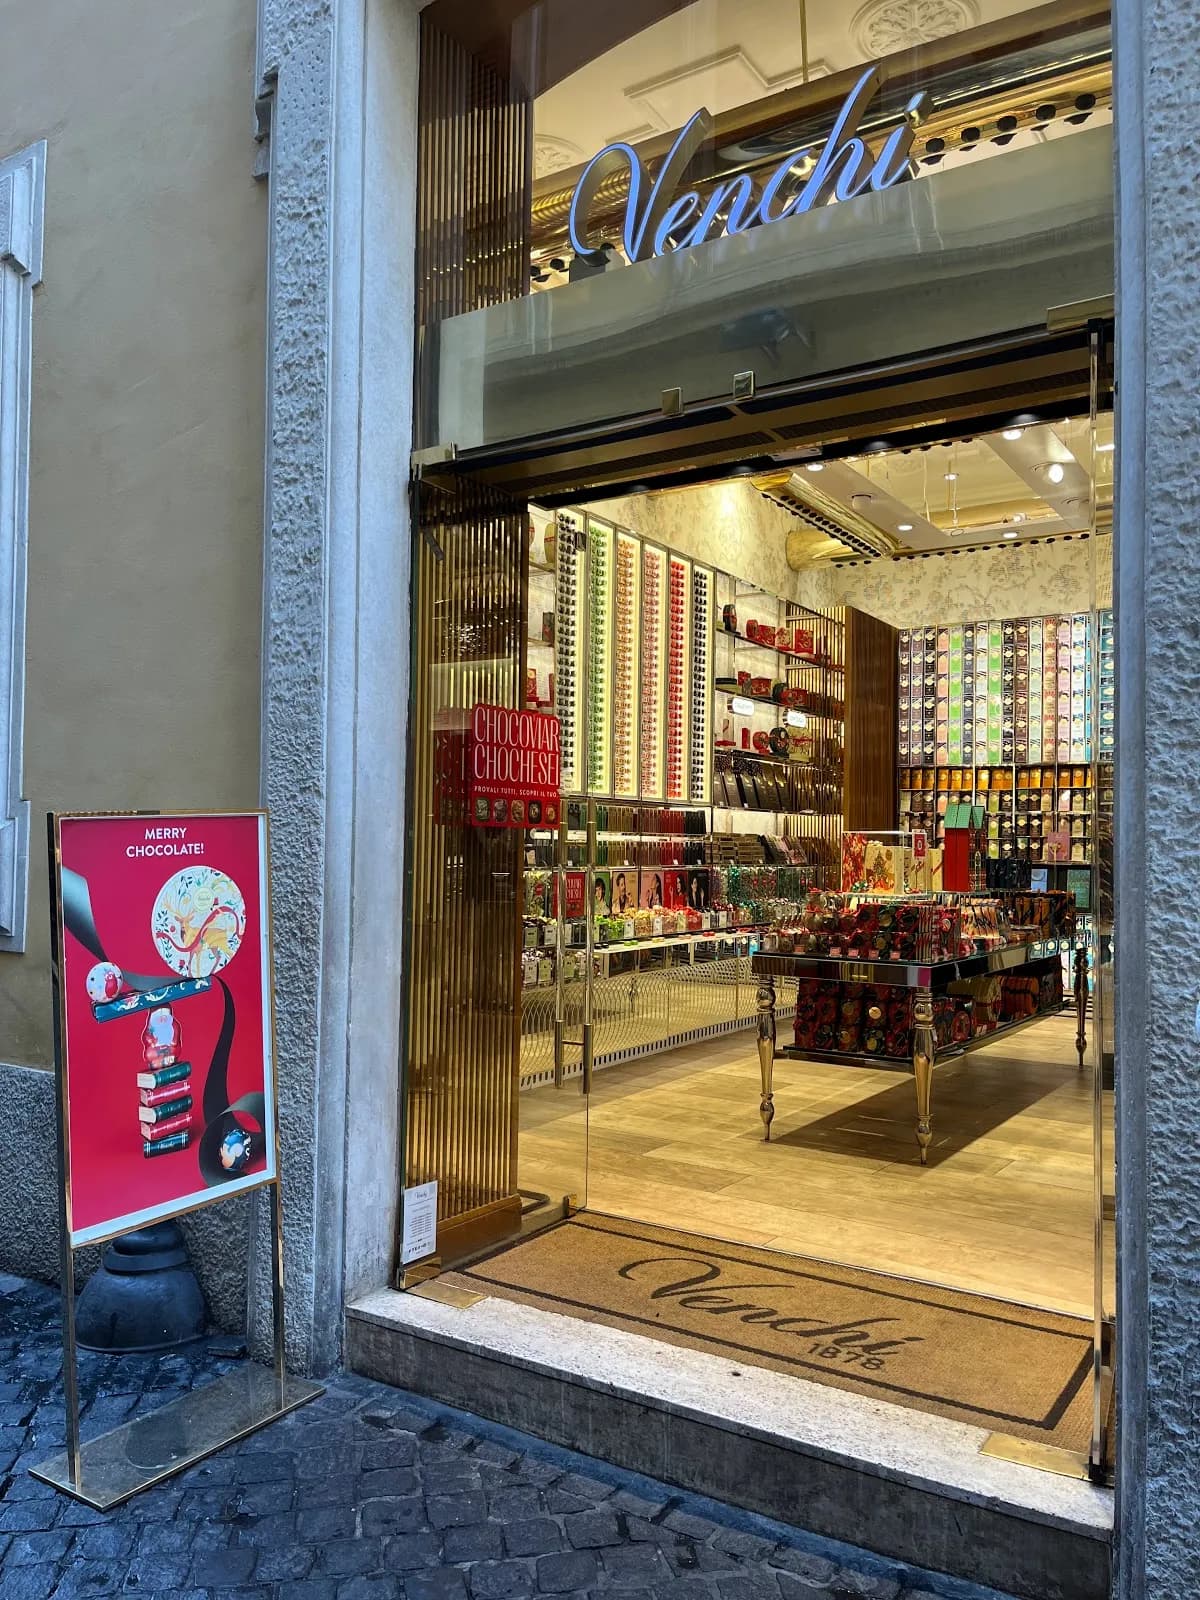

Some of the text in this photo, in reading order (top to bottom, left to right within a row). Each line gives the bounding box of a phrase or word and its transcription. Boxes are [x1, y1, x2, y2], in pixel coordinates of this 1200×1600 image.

[569, 66, 927, 263] Venchi
[475, 707, 559, 751] CHOCOVIAR
[474, 743, 559, 786] CHOCHESEI
[126, 843, 204, 857] CHOCOLATE!
[145, 828, 187, 840] MERRY
[618, 1258, 925, 1357] Venchi
[807, 1342, 886, 1371] 1878
